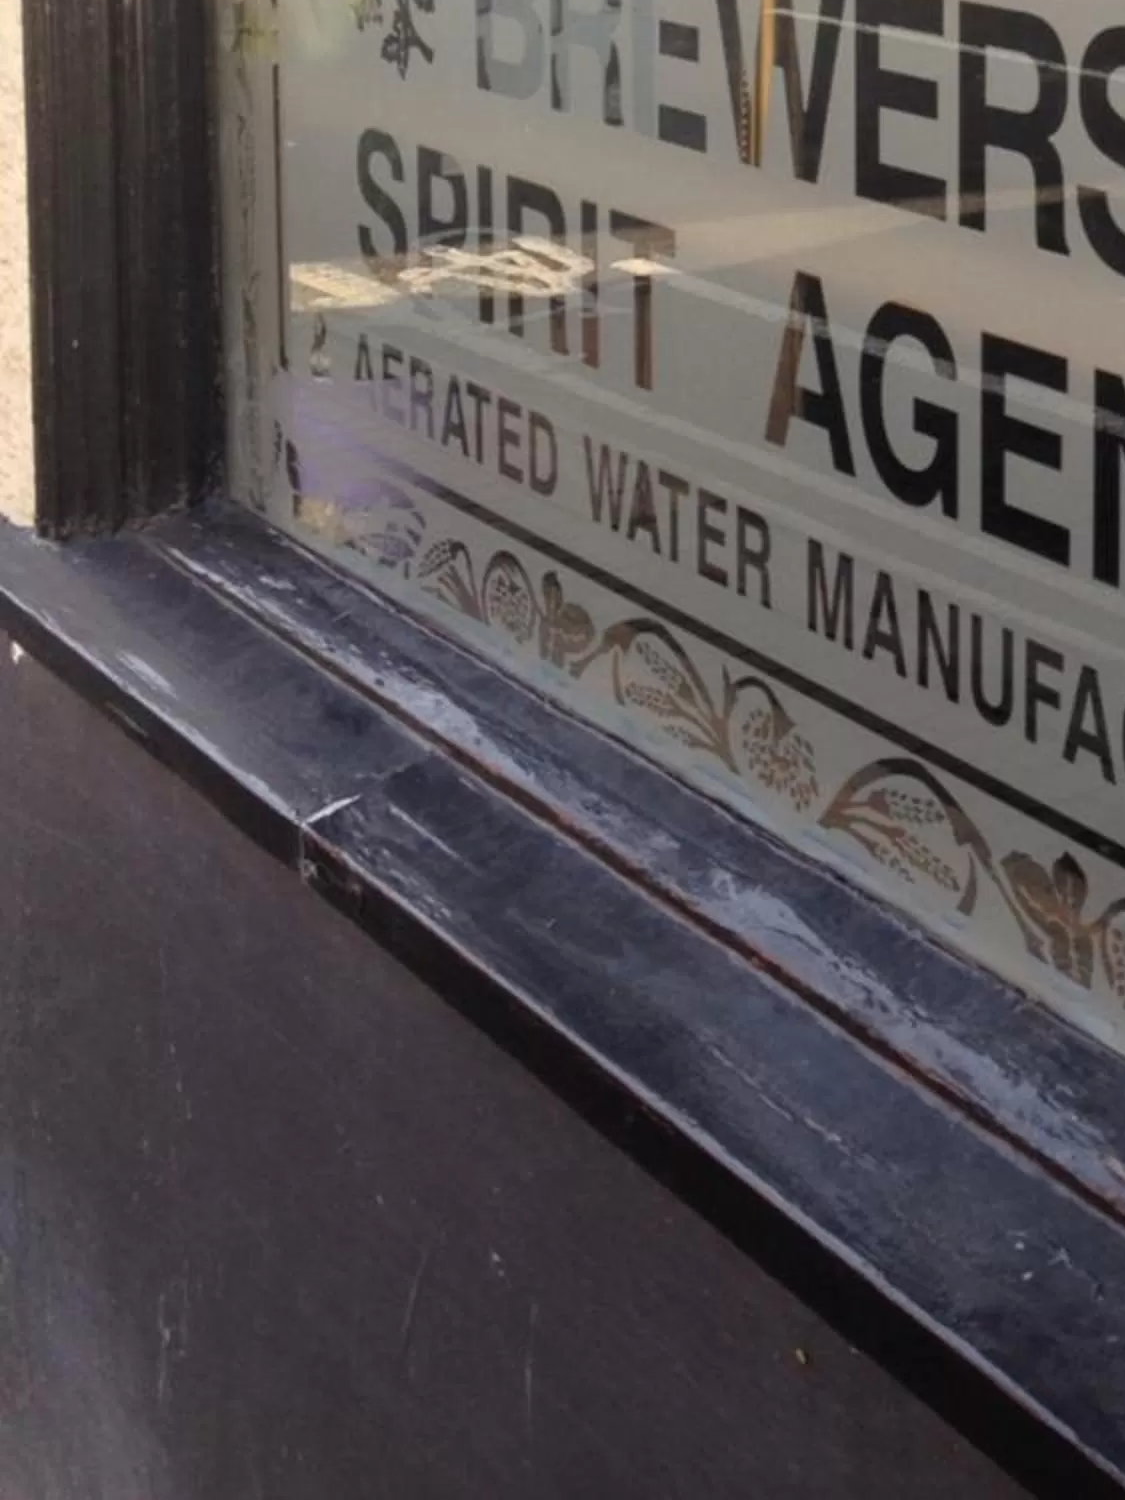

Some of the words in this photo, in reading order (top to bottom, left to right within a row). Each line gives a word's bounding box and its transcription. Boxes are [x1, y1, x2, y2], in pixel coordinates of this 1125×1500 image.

[356, 127, 676, 391] SPIRIT
[353, 332, 558, 497] AERATED
[583, 435, 773, 610] WATER
